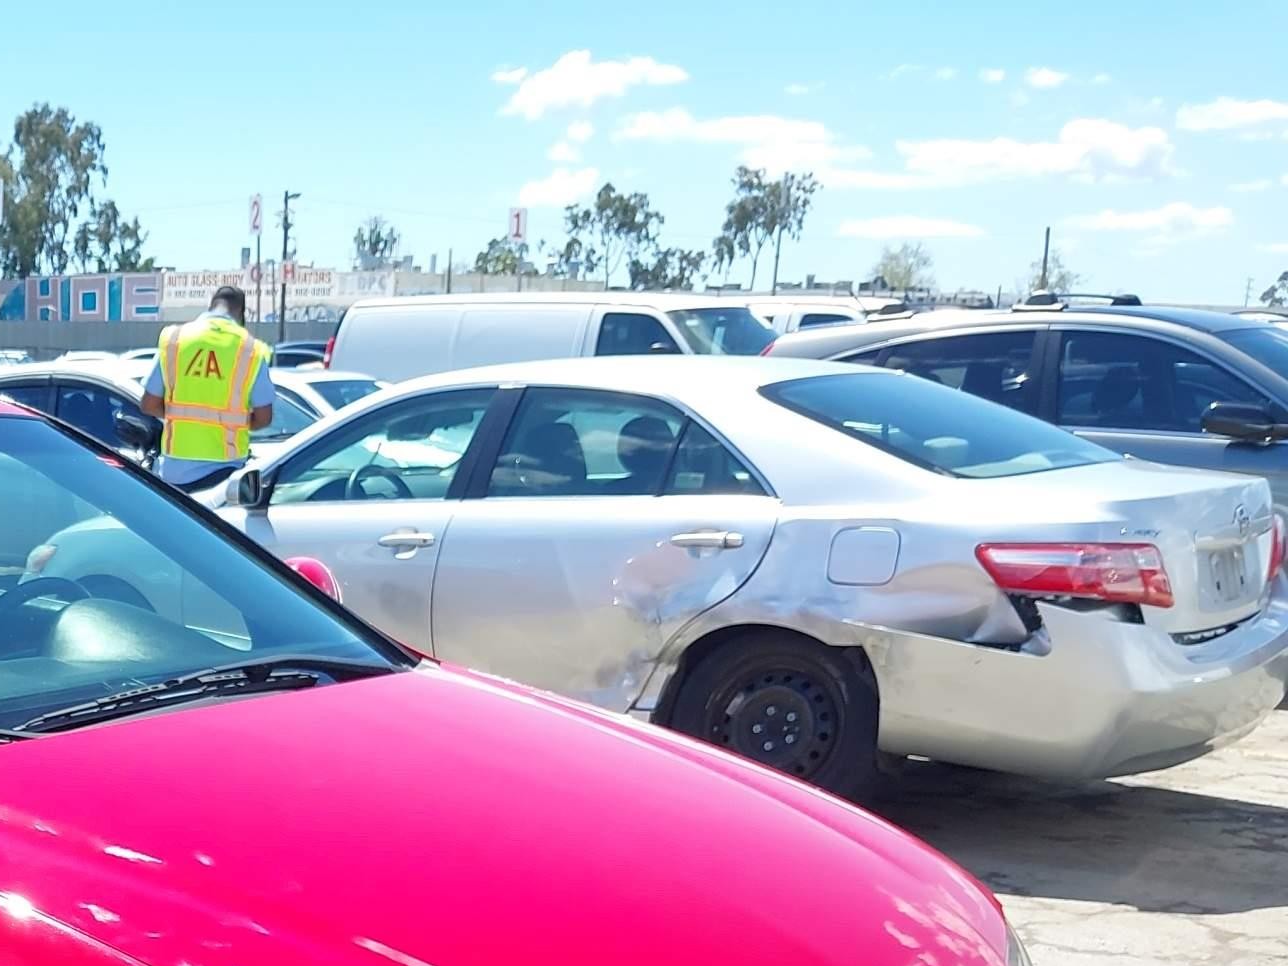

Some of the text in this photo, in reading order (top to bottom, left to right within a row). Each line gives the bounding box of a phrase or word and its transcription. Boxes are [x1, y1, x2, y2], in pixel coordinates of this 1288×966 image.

[252, 200, 260, 230] 2
[512, 212, 522, 238] 1
[283, 262, 295, 280] H
